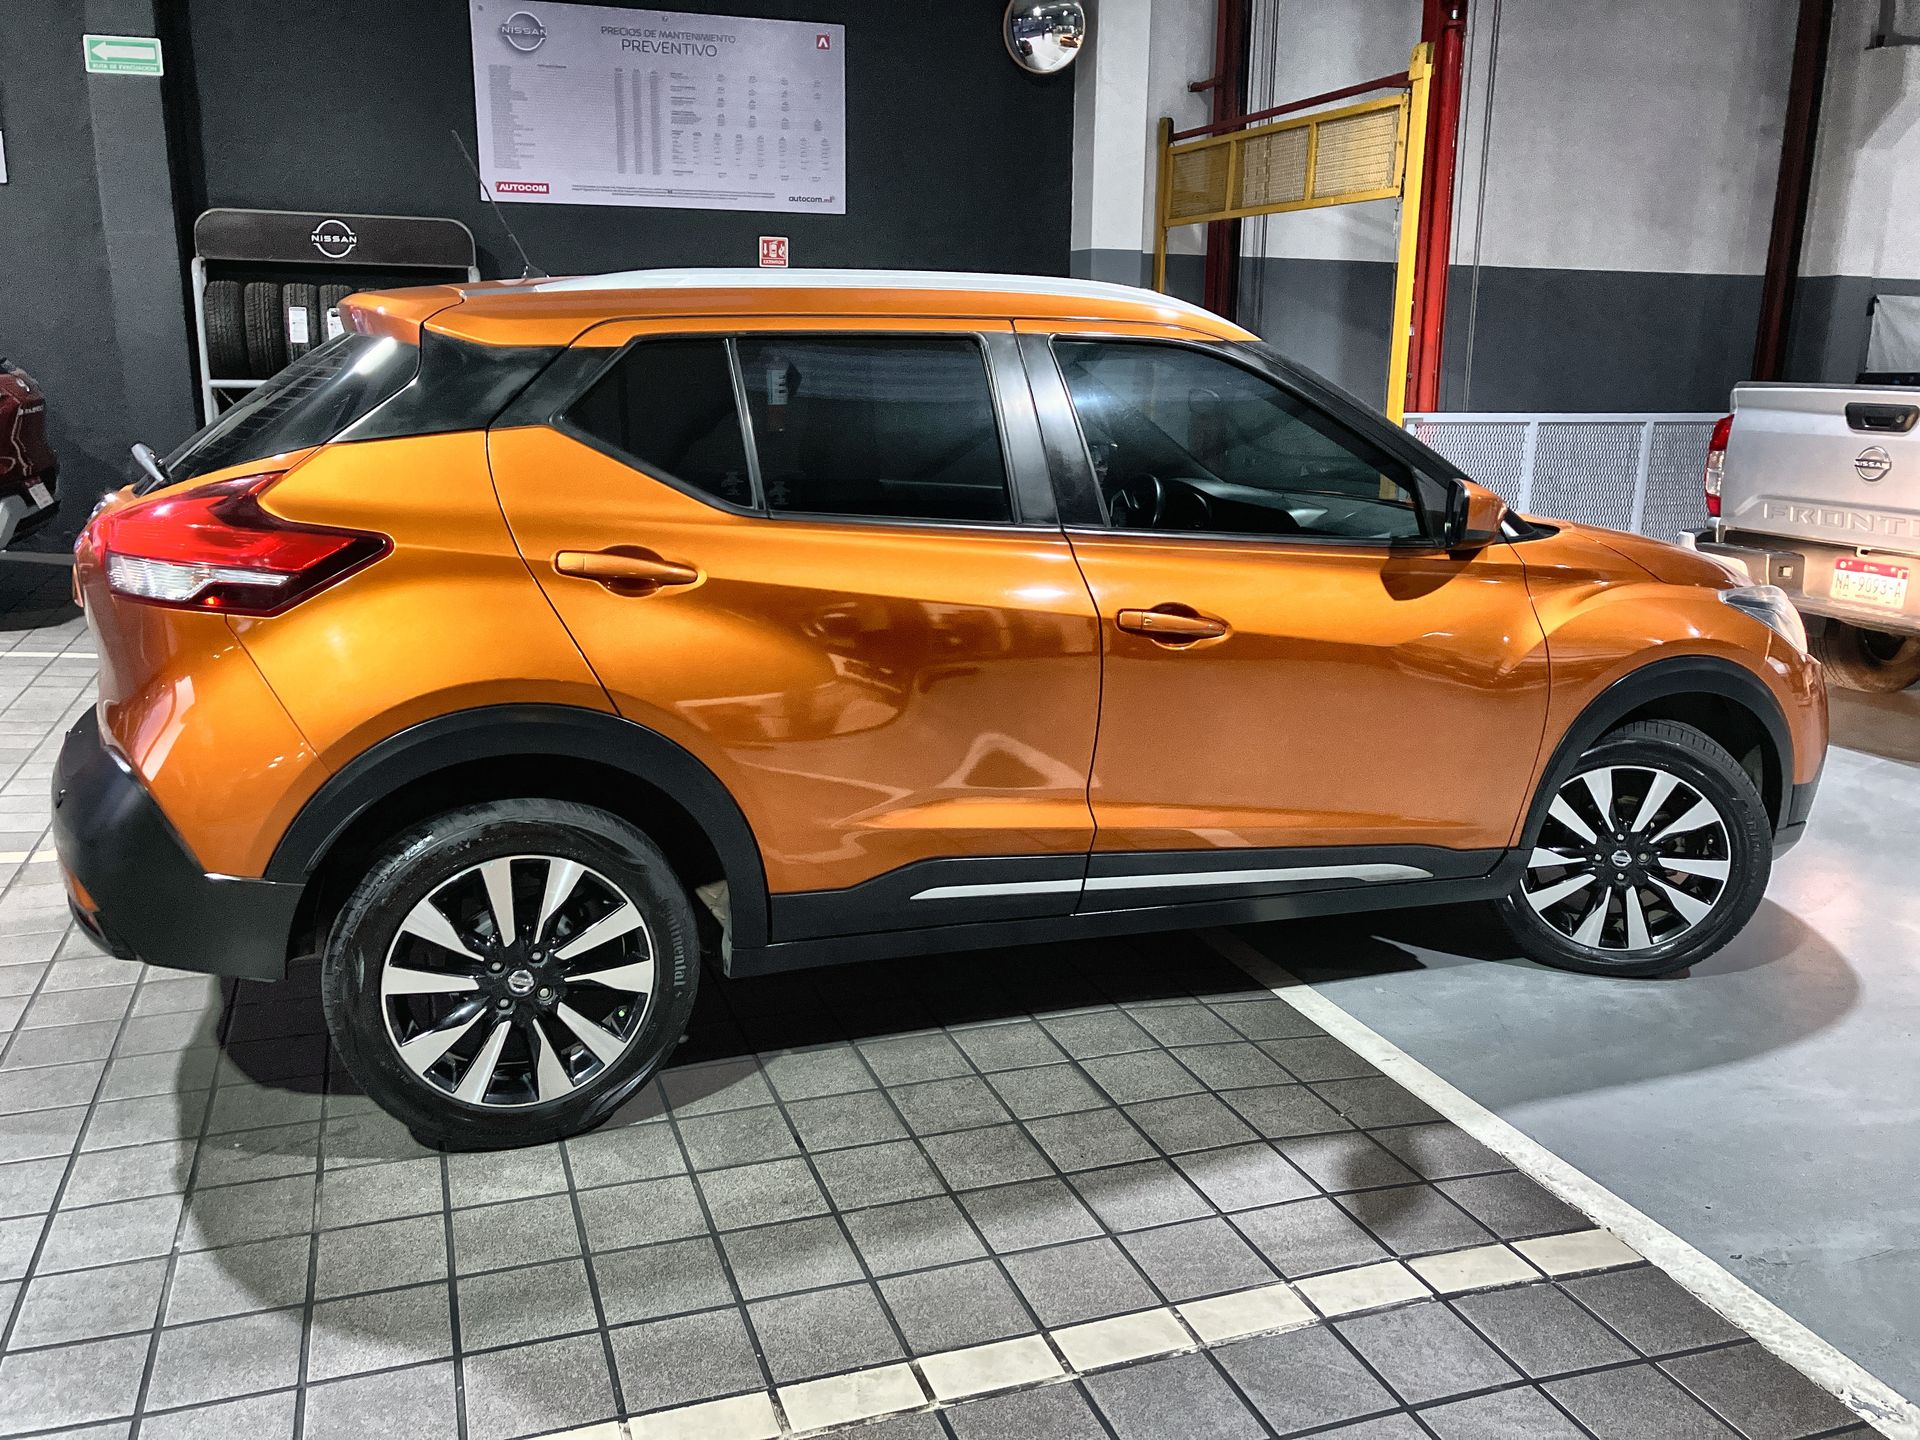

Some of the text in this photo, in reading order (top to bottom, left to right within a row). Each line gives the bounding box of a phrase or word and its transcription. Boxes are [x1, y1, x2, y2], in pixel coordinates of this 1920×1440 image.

[501, 26, 548, 36] NISSAN
[600, 26, 737, 44] PRECIOS DE MANTENIMIENTO
[621, 39, 718, 57] PREVENTIVO
[499, 183, 547, 192] AUTOCOM
[311, 234, 357, 243] NISSAN
